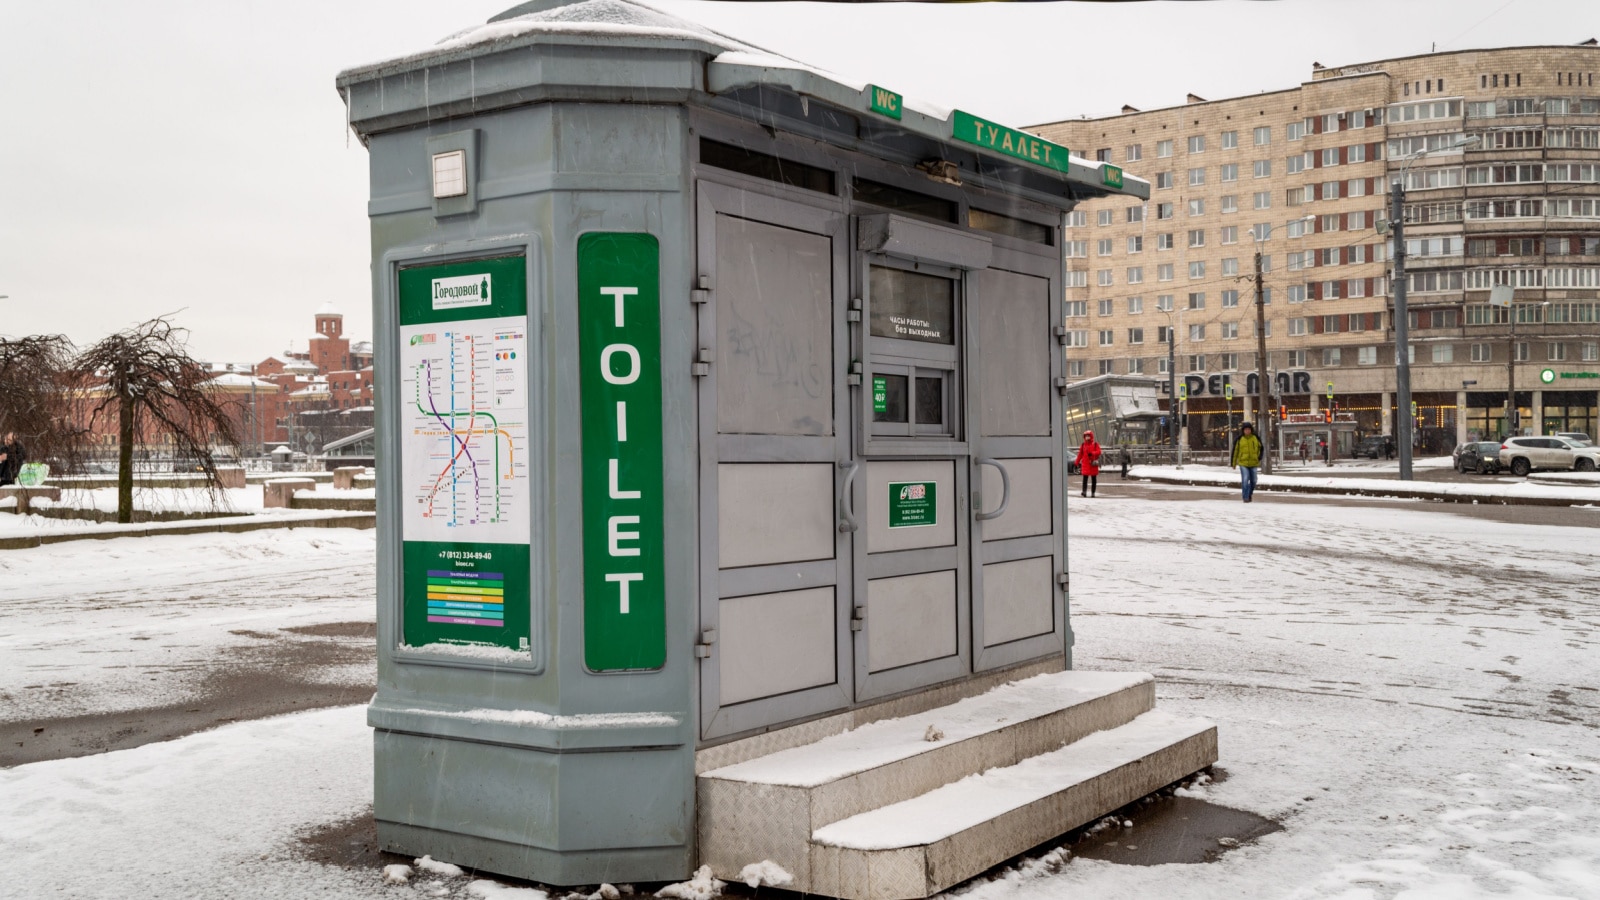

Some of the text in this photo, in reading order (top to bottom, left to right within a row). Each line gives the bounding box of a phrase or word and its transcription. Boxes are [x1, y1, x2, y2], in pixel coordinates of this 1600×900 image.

[875, 88, 897, 111] WC
[973, 121, 1052, 163] ТУАЛЕТ
[1107, 170, 1121, 183] WC
[889, 316, 930, 328] ЧАСЫ РАБОТЫ:
[895, 324, 941, 338] без выходных
[599, 286, 644, 615] TOILET
[438, 550, 492, 560] +7 (812) 334-89-40
